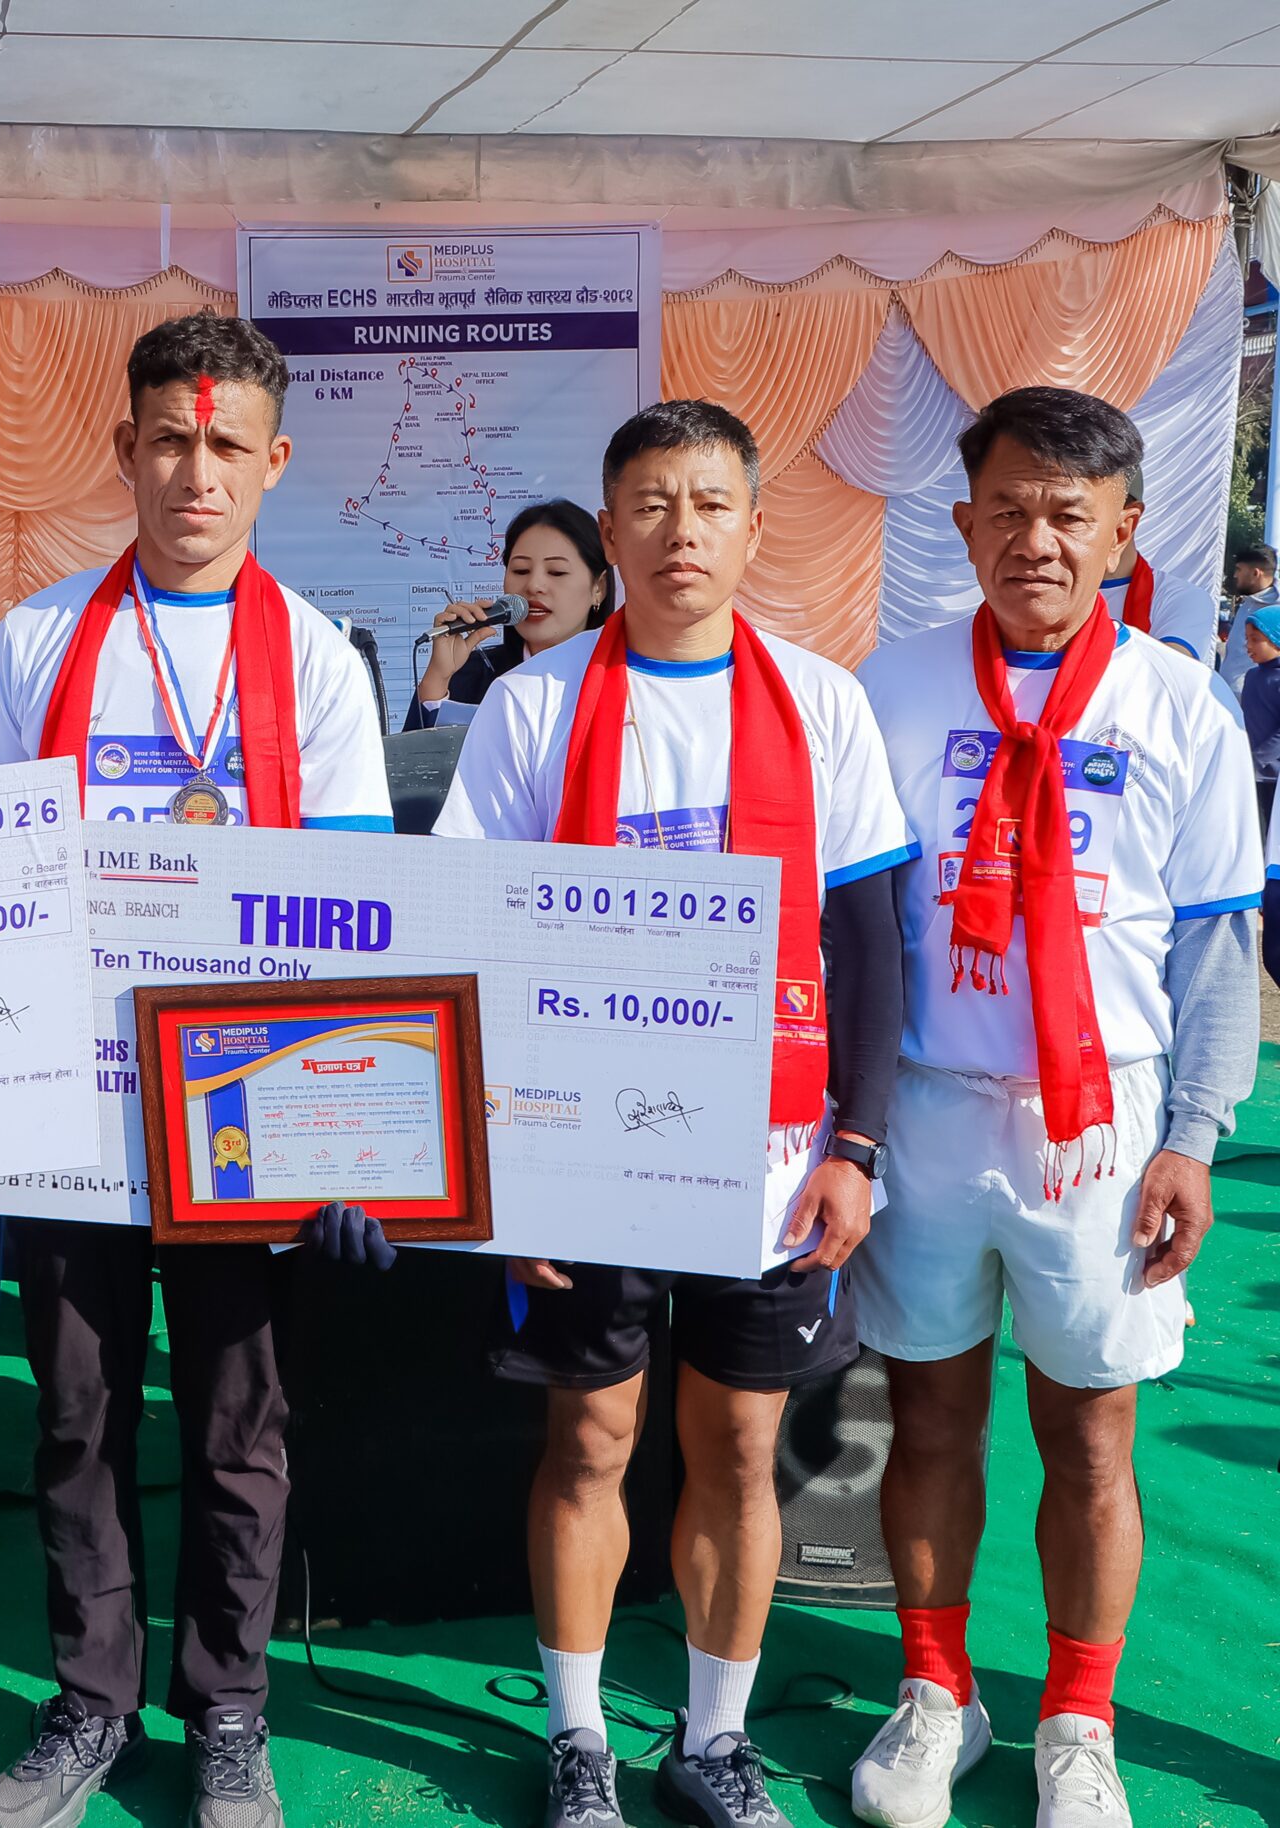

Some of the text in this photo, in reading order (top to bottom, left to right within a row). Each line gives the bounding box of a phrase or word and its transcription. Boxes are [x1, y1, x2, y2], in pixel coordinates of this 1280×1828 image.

[434, 245, 494, 255] MEDIPLUS
[434, 258, 495, 267] HOSPITAL
[434, 273, 495, 282] Trauma Center
[268, 290, 322, 309] मेडिप्लस
[327, 289, 377, 308] ECHS
[386, 288, 434, 308] भारतीय
[438, 288, 476, 310] भूतपूर्व
[484, 286, 523, 306] सैनिक
[527, 289, 572, 306] स्वास्थ्य
[353, 322, 553, 345] RUNNING ROUTES
[287, 368, 385, 383] otal Distance
[314, 387, 354, 400] 6 KM
[320, 588, 354, 597] Location
[411, 586, 446, 594] Distance
[355, 607, 380, 615] Ground
[378, 616, 397, 624] Point)
[22, 861, 68, 875] Or Bearer
[98, 850, 199, 873] IME Bank
[505, 884, 529, 896] Date
[124, 901, 180, 919] BRANCH
[506, 898, 526, 911] मिति
[231, 893, 393, 952] THIRD
[90, 947, 312, 981] Ten Thousand Only
[709, 962, 760, 976] Or Bearer
[537, 988, 734, 1028] Rs. 10,000/-
[222, 1026, 268, 1037] MEDIPLUS
[223, 1035, 270, 1045] HOSPITAL
[224, 1047, 270, 1056] Trauma Center
[316, 1062, 362, 1073] प्रमाण-पत्र
[514, 1088, 581, 1103] MEDIPLUS
[513, 1101, 582, 1116] HOSPITAL
[513, 1118, 582, 1131] Trauma Center
[222, 1138, 243, 1153] 3rd
